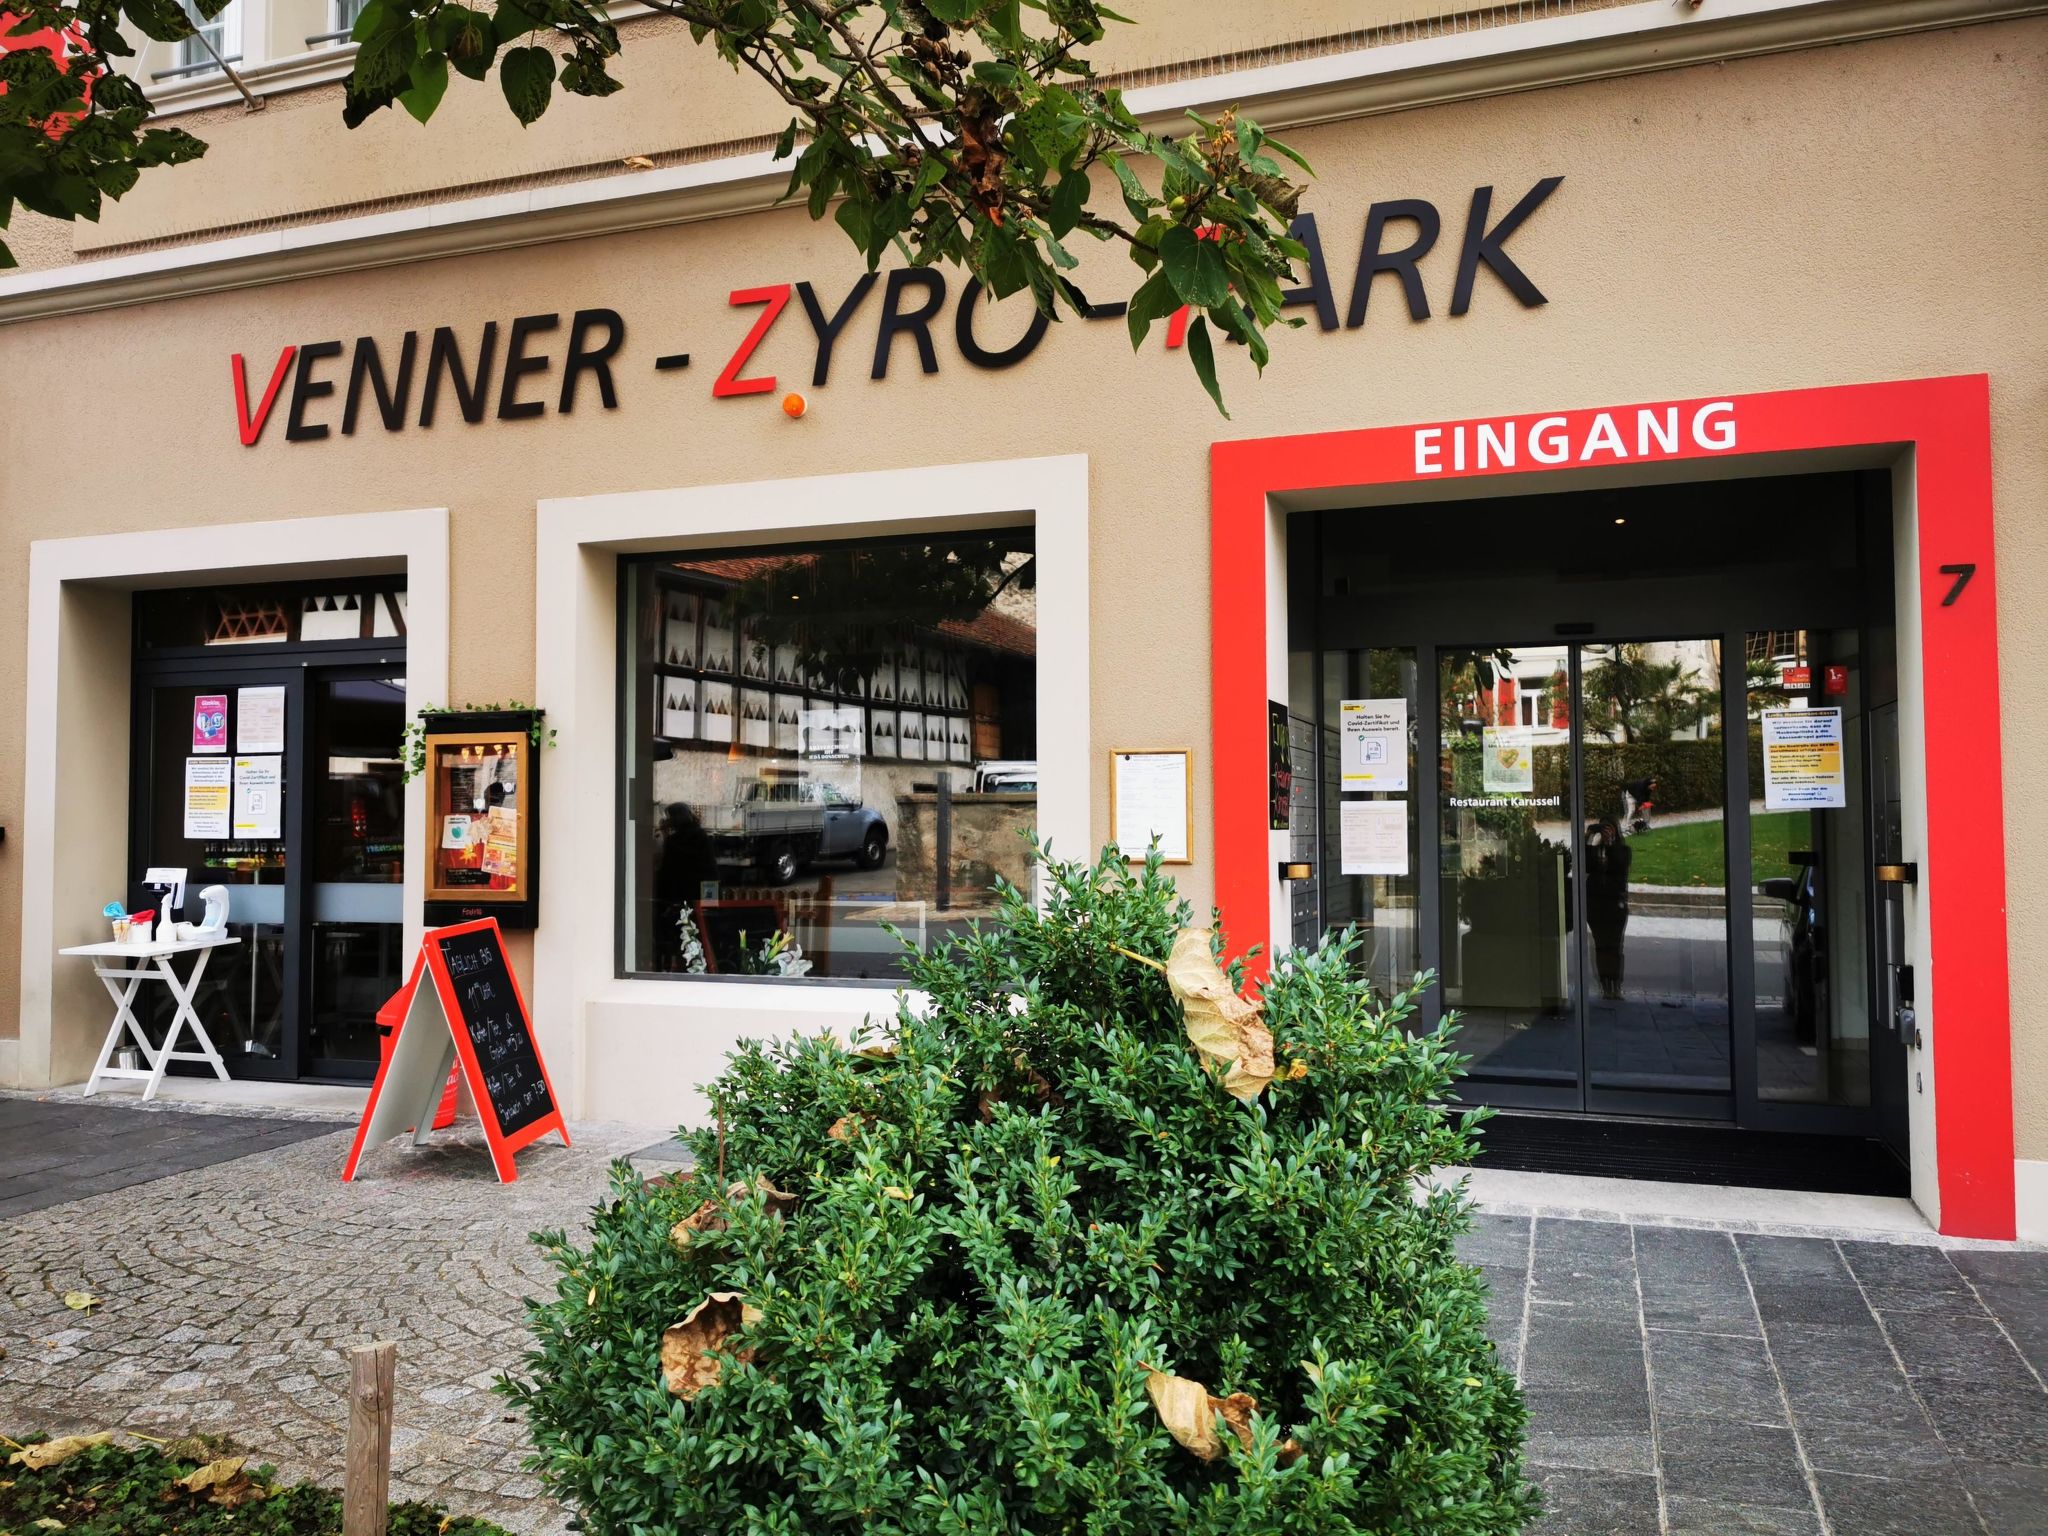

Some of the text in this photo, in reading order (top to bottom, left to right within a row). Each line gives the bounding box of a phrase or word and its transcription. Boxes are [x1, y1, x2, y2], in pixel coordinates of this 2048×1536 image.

[231, 308, 625, 446] VENNER
[655, 353, 691, 371] -
[713, 267, 1052, 398] ZYRO
[1414, 402, 1737, 474] EINGANG
[1939, 563, 1976, 607] 7
[1449, 795, 1560, 807] Restaurant Karussell
